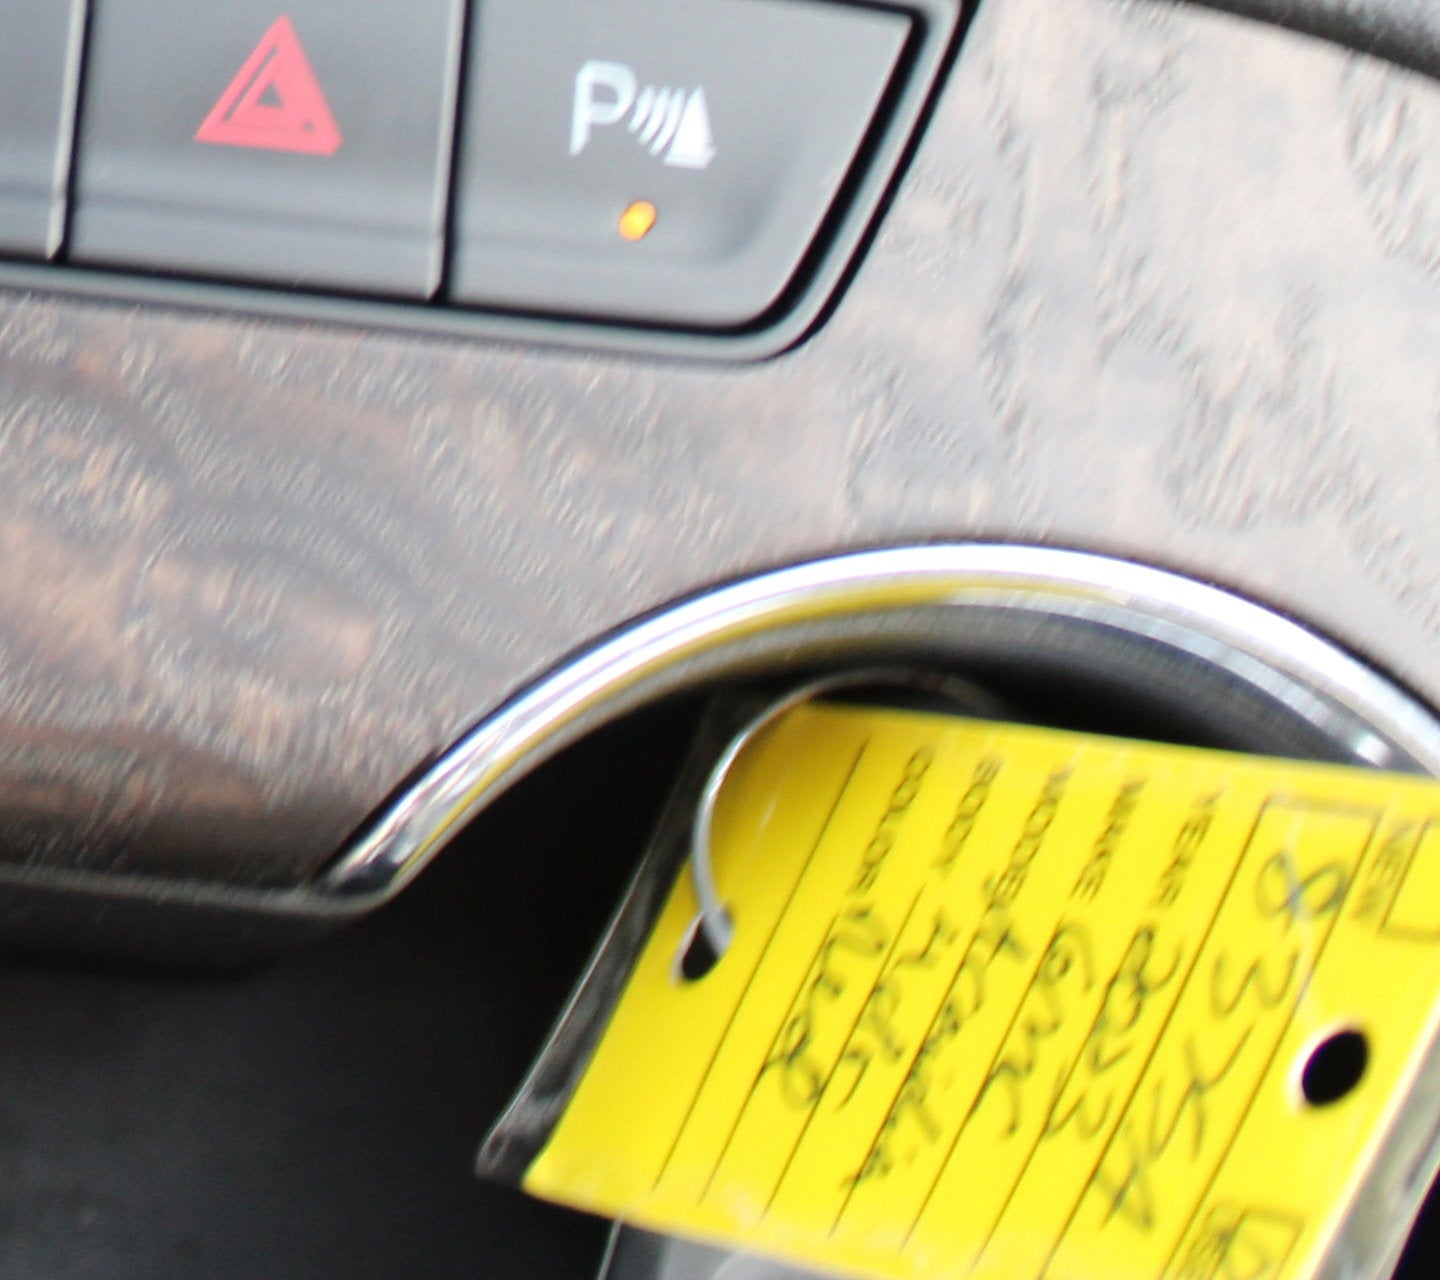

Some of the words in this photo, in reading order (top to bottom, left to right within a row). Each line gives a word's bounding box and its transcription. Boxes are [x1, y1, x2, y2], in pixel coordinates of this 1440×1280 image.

[569, 59, 638, 156] P
[848, 743, 935, 897] COLOR
[935, 753, 1003, 872] BODY
[1070, 776, 1146, 905] MAKE
[1154, 787, 1224, 910] YEAR
[1353, 817, 1418, 923] NEW
